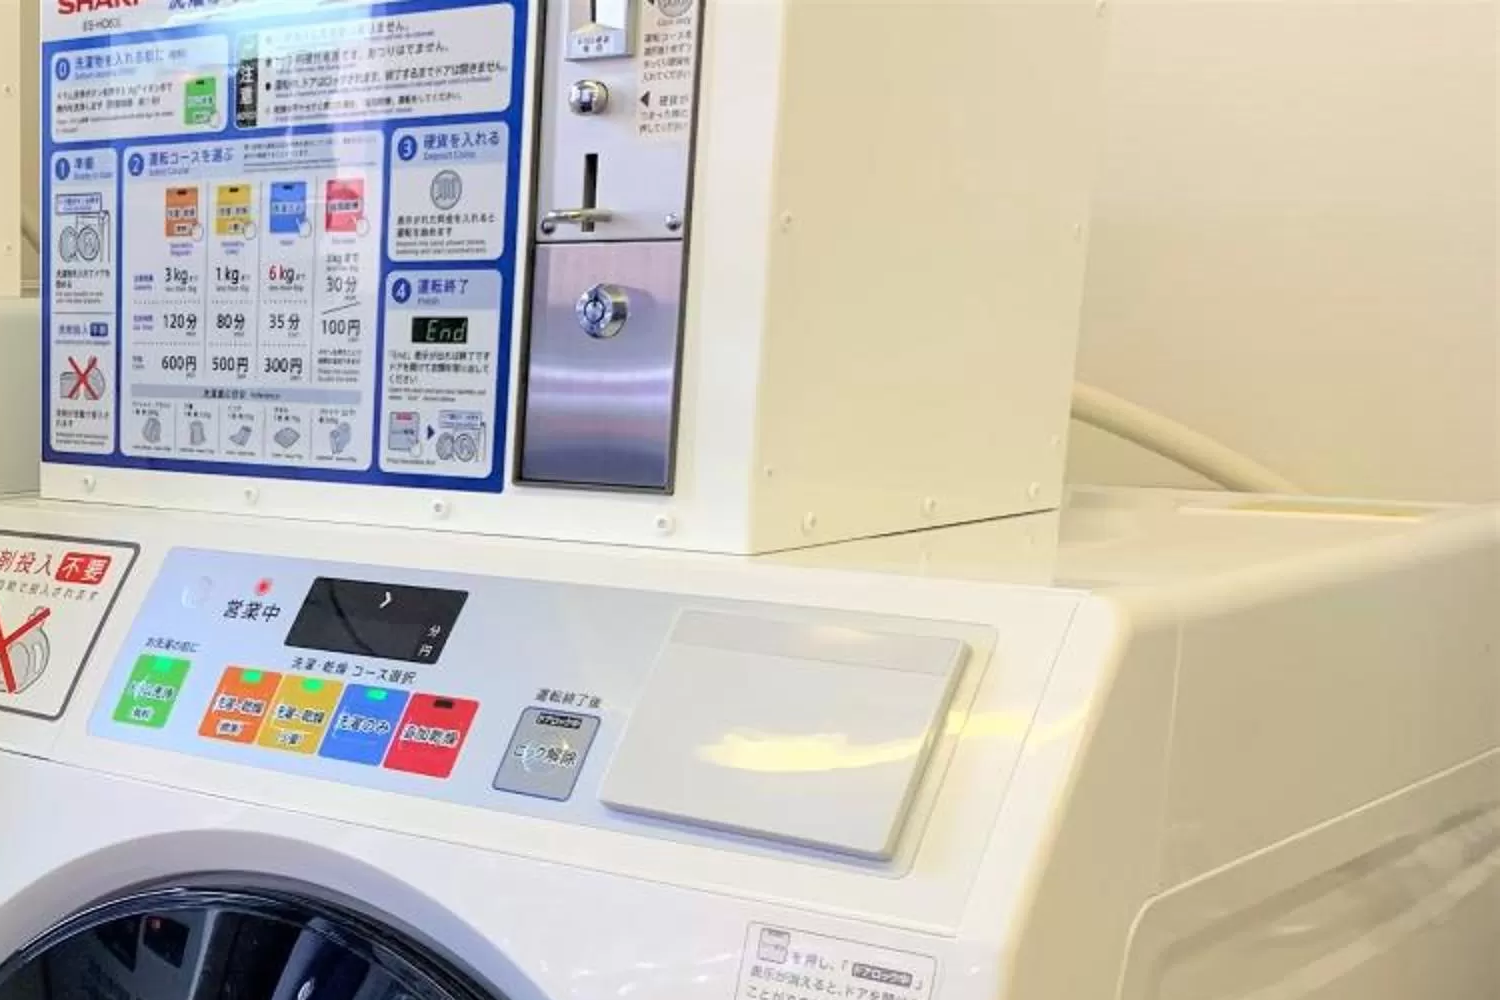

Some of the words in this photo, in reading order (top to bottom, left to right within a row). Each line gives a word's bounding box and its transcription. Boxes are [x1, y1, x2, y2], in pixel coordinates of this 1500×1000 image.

[424, 132, 500, 148] 硬貨を入れる
[149, 147, 234, 166] 運転コースを選ぶ
[326, 276, 358, 293] 30分
[417, 279, 469, 295] 運転終了
[163, 313, 197, 330] 120分
[216, 314, 245, 331] 80分
[269, 314, 300, 331] 35分
[321, 319, 361, 338] 100円
[425, 319, 467, 342] End
[161, 354, 197, 372] 600円
[212, 355, 249, 373] 500円
[264, 356, 303, 374] 300円
[59, 556, 106, 582] 不要
[223, 599, 281, 622] 営業中
